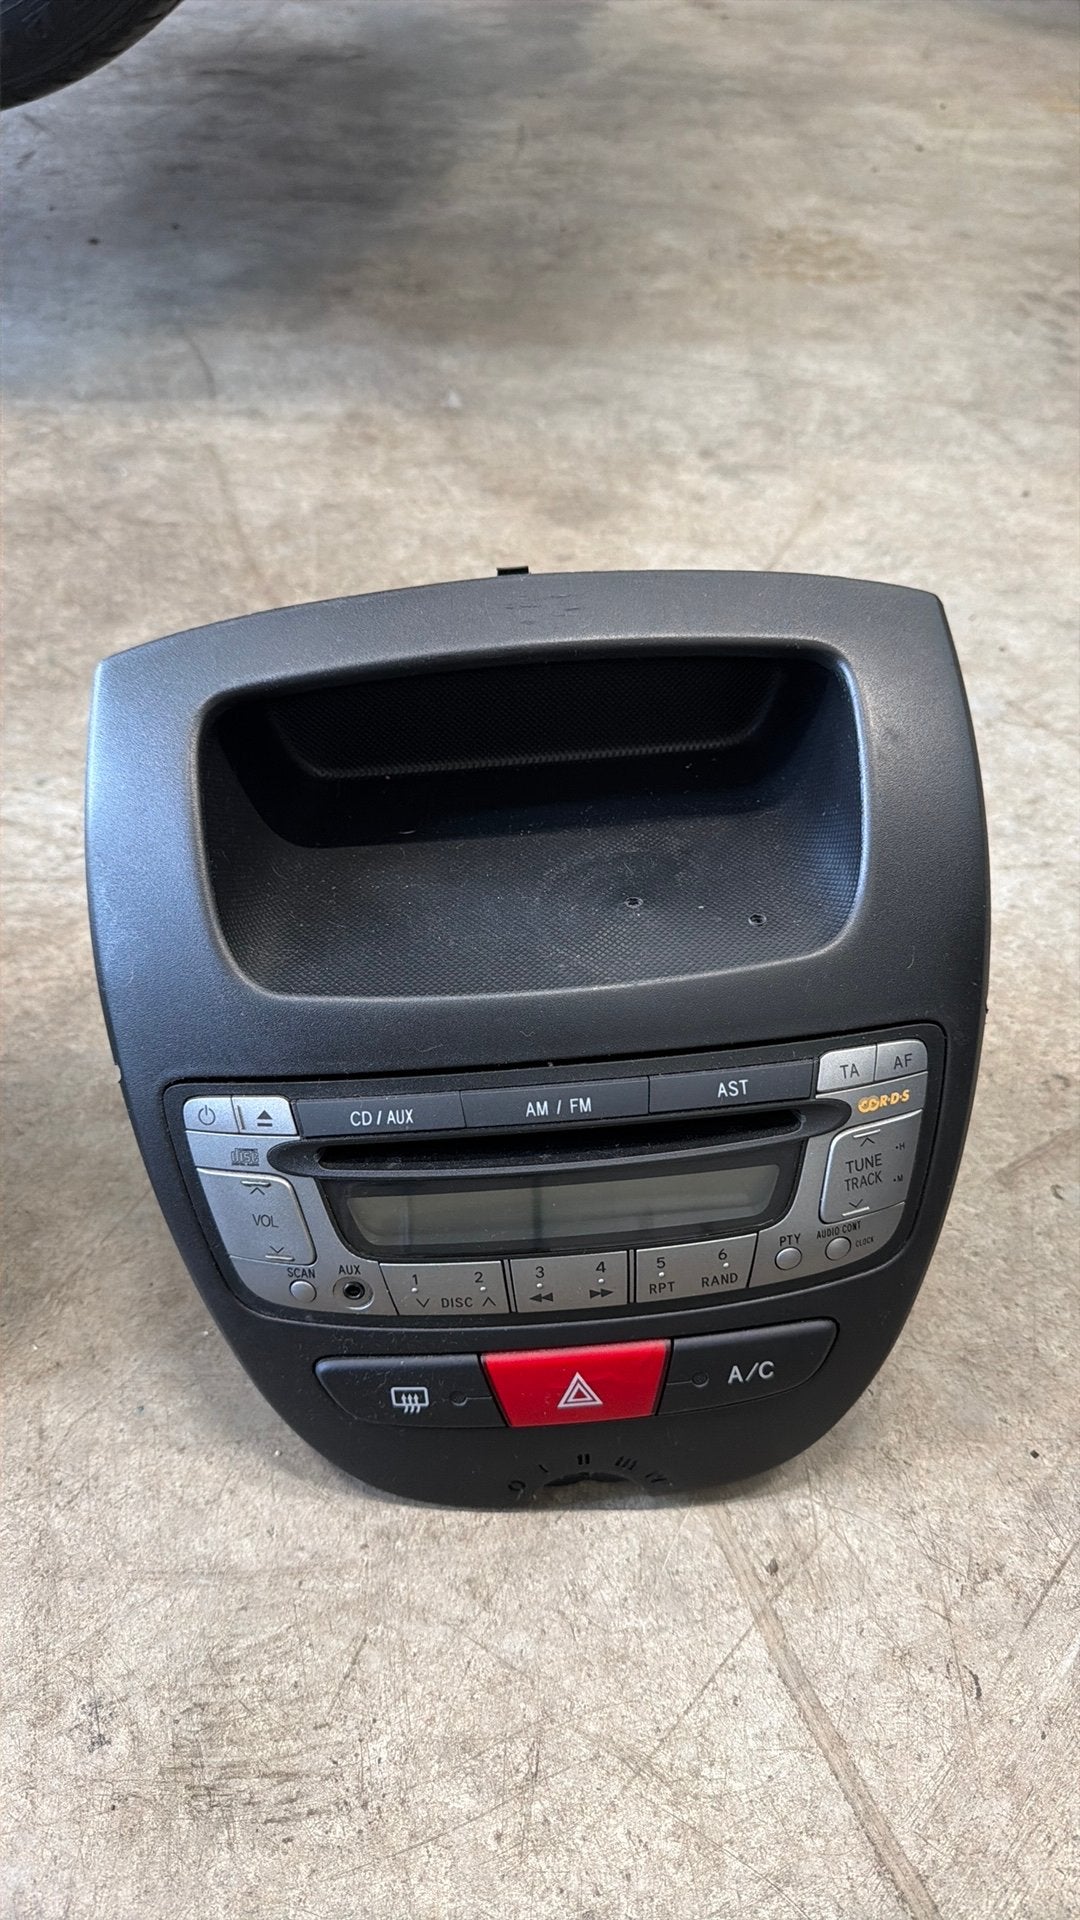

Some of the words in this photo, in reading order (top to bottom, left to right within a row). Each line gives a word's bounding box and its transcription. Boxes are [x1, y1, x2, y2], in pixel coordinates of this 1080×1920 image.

[893, 1053, 913, 1070] AF
[839, 1063, 860, 1079] TA
[717, 1079, 749, 1098] AST
[525, 1102, 549, 1117] AM
[570, 1098, 592, 1113] FM
[350, 1111, 373, 1127] CD
[387, 1109, 414, 1125] AUX
[845, 1153, 882, 1174] TUNE
[844, 1171, 882, 1192] TRACK
[252, 1213, 279, 1228] VOL
[816, 1226, 840, 1239] AUDIO
[841, 1220, 861, 1234] CONT
[779, 1233, 801, 1246] PTY
[855, 1236, 874, 1248] CLOCK
[718, 1248, 727, 1261] 6
[596, 1260, 606, 1273] 4
[656, 1256, 666, 1269] 5
[286, 1267, 316, 1280] SCAN
[338, 1264, 361, 1276] AUX
[535, 1265, 545, 1279] 3
[411, 1274, 418, 1286] 1
[474, 1271, 483, 1284] 2
[701, 1272, 739, 1289] RAND
[649, 1281, 676, 1295] RPT
[440, 1296, 473, 1309] DISC
[727, 1359, 776, 1385] A/C
